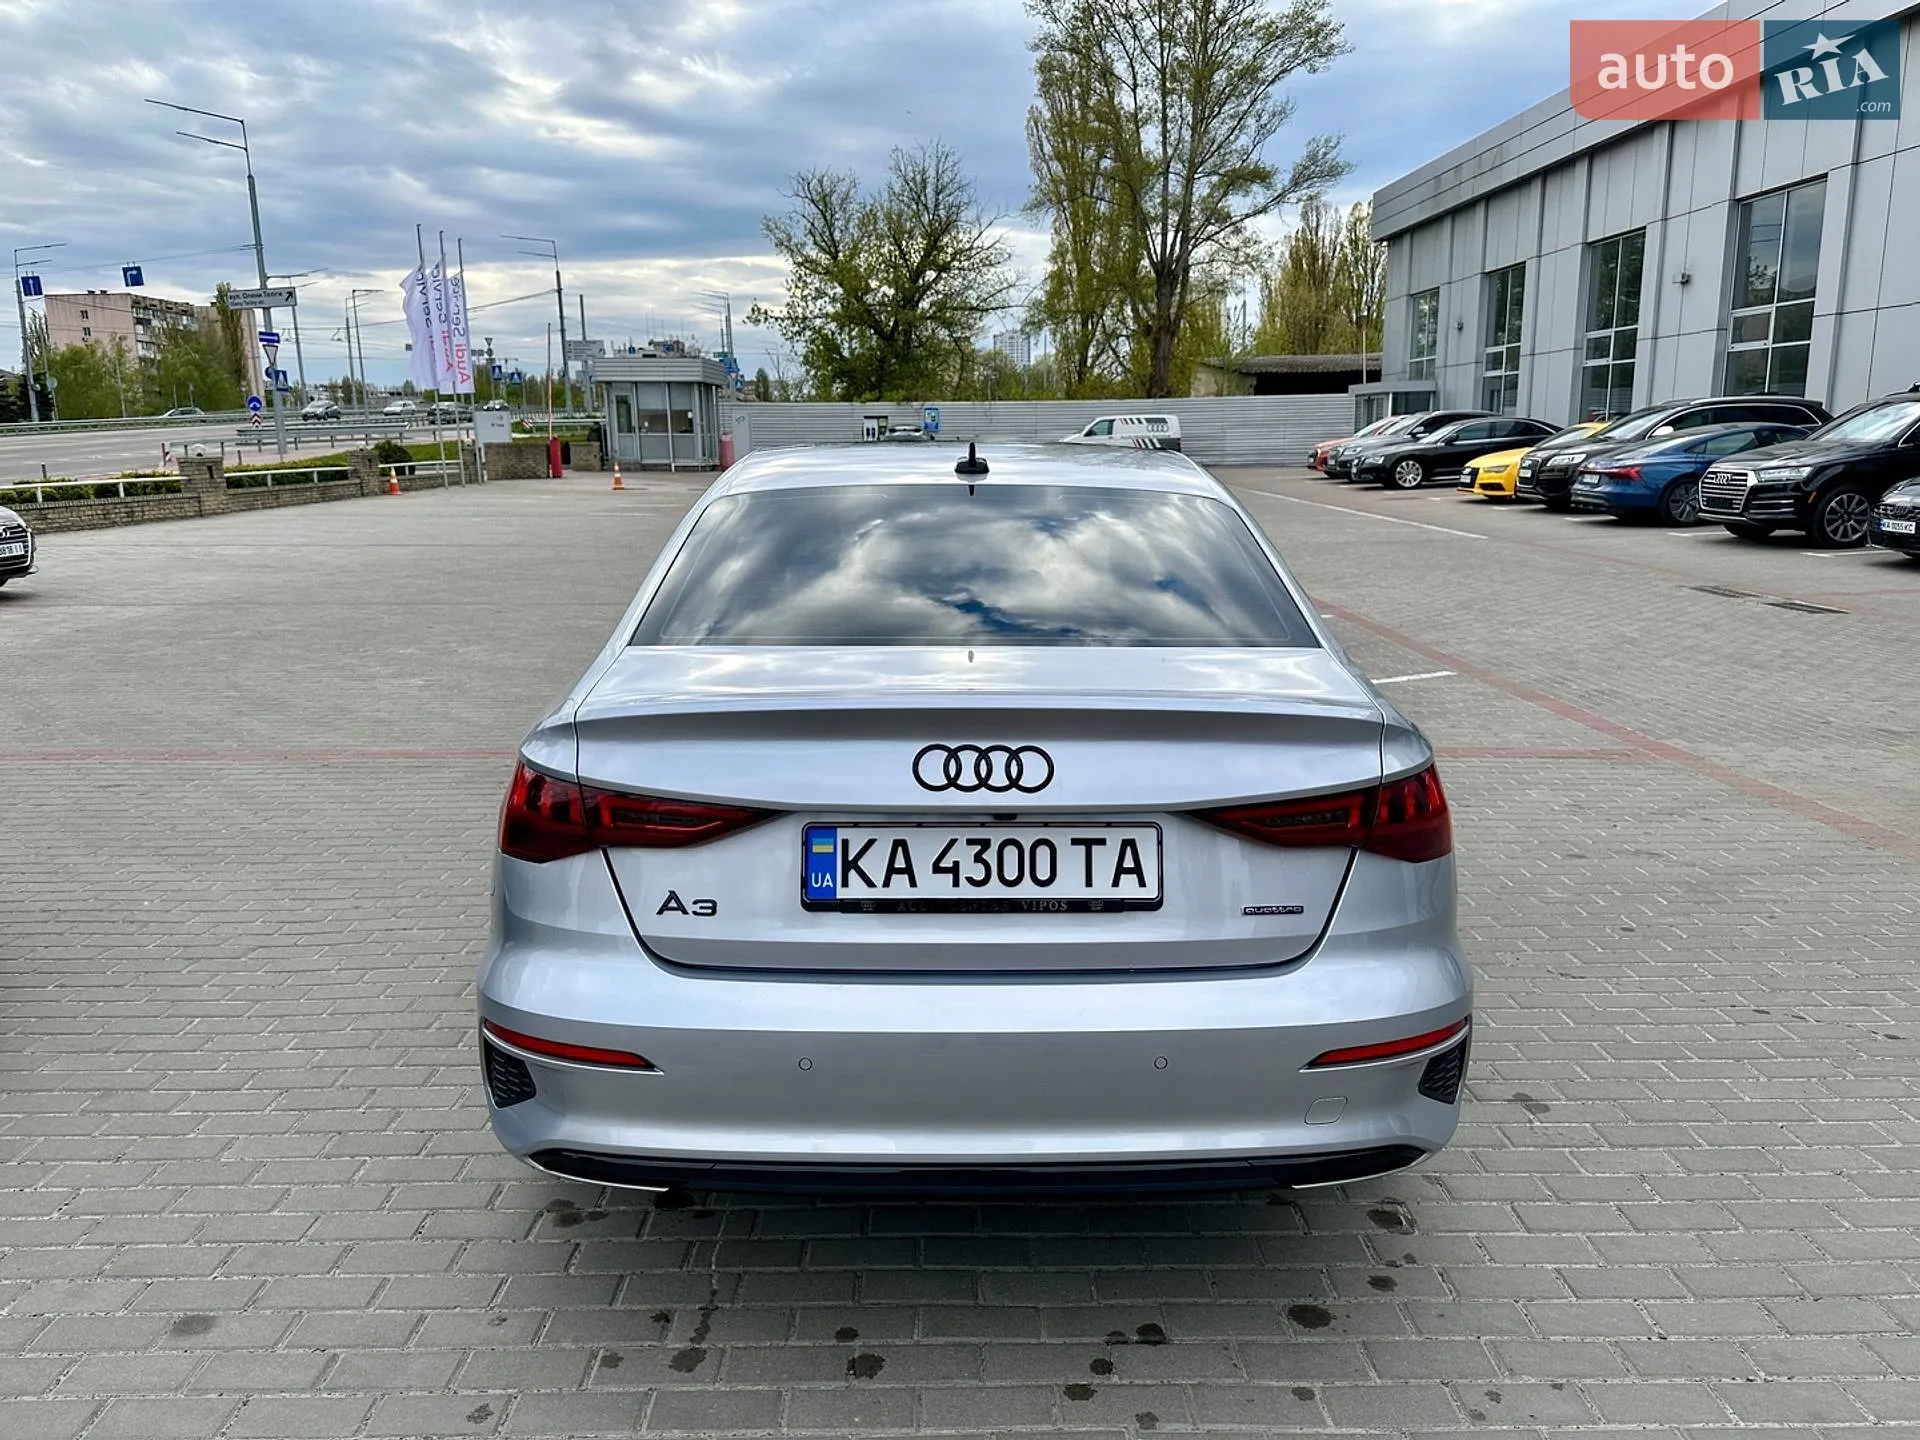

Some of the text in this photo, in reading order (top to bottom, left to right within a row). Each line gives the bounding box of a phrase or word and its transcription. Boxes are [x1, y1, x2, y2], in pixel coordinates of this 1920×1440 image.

[841, 838, 1147, 888] KA 4300 TA
[811, 873, 833, 889] UA
[655, 890, 717, 917] A3
[1021, 901, 1068, 911] VIPOS
